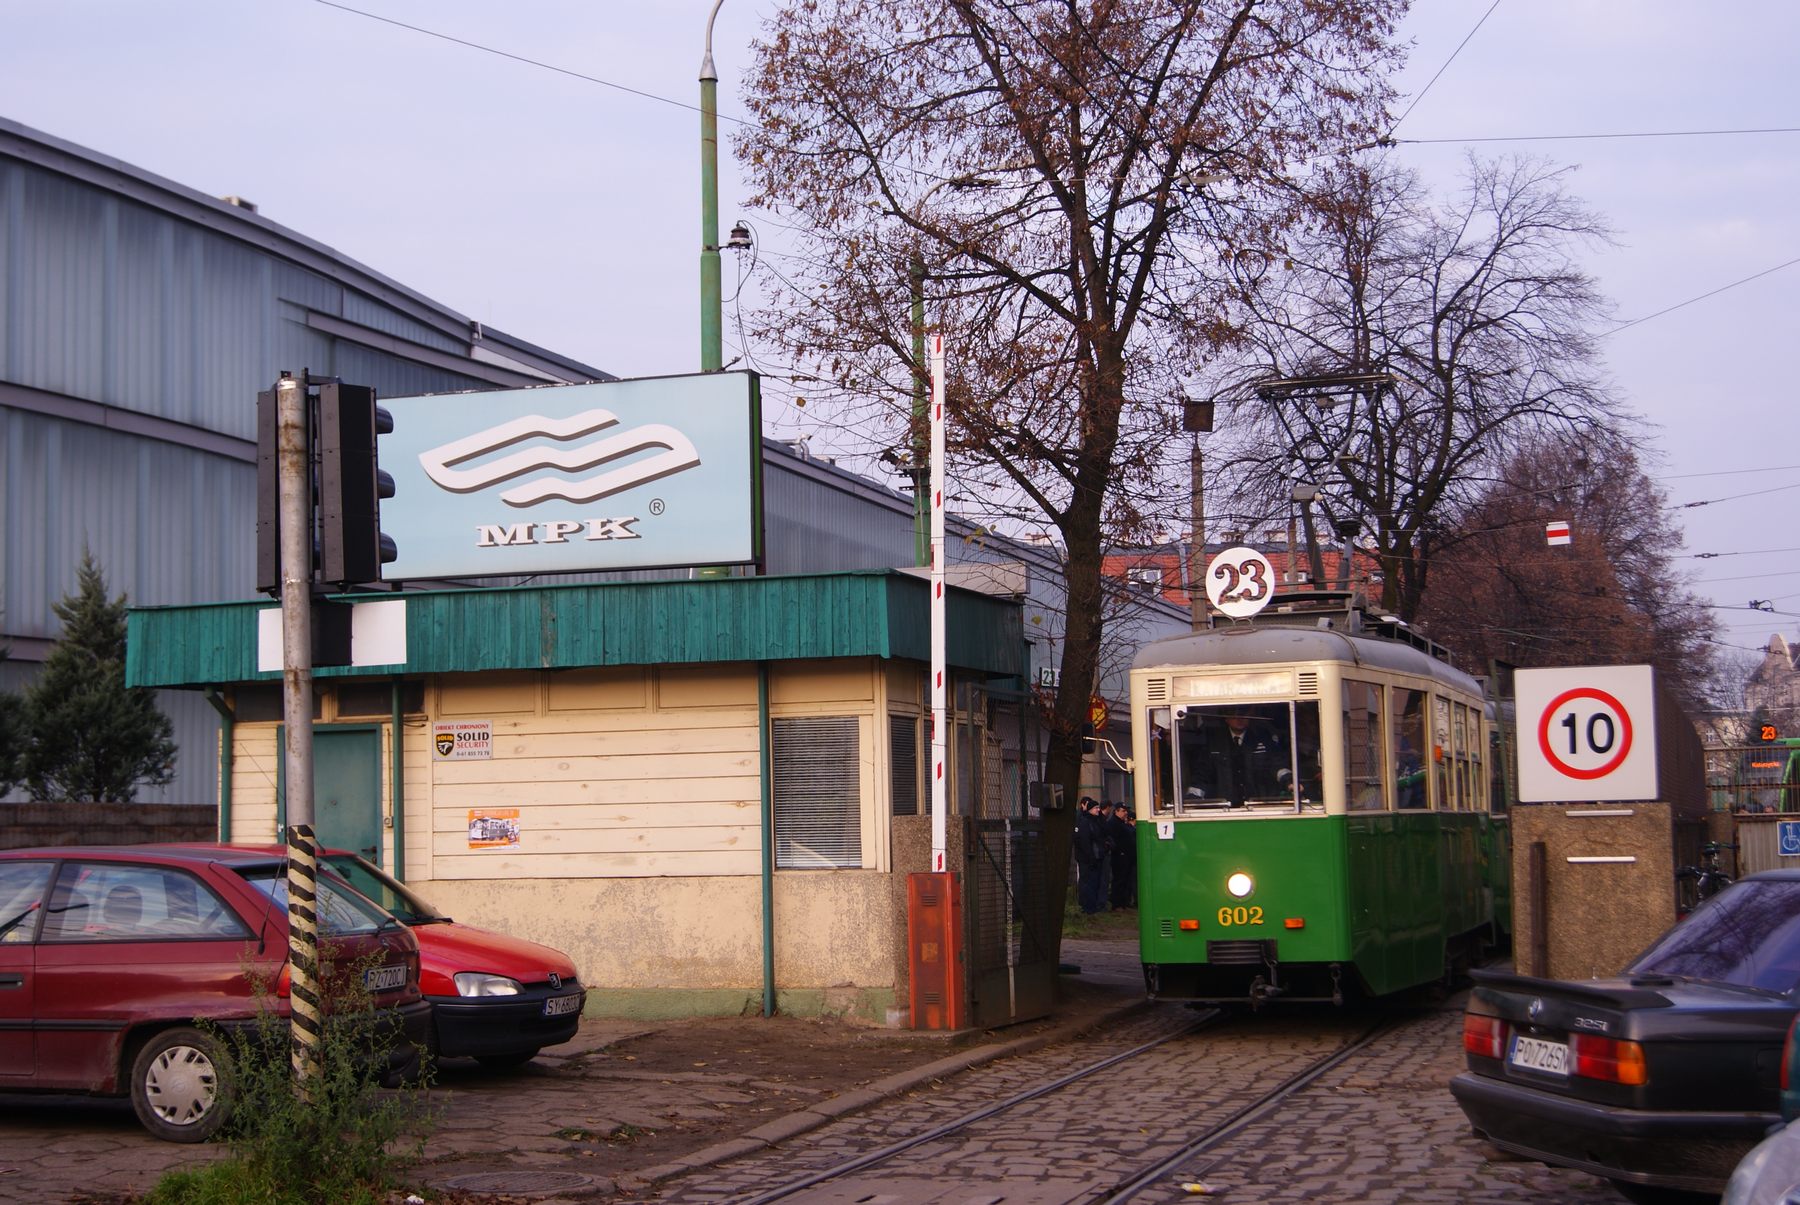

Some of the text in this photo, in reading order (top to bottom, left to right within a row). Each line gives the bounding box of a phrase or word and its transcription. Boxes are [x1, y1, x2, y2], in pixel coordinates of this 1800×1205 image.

[476, 516, 642, 547] MPK
[1215, 559, 1267, 605] 23
[456, 732, 489, 742] SOLID
[1562, 712, 1614, 754] 10
[1762, 726, 1775, 740] 23
[456, 741, 489, 749] SECURITY
[1163, 825, 1169, 835] 1
[1217, 906, 1264, 926] 602
